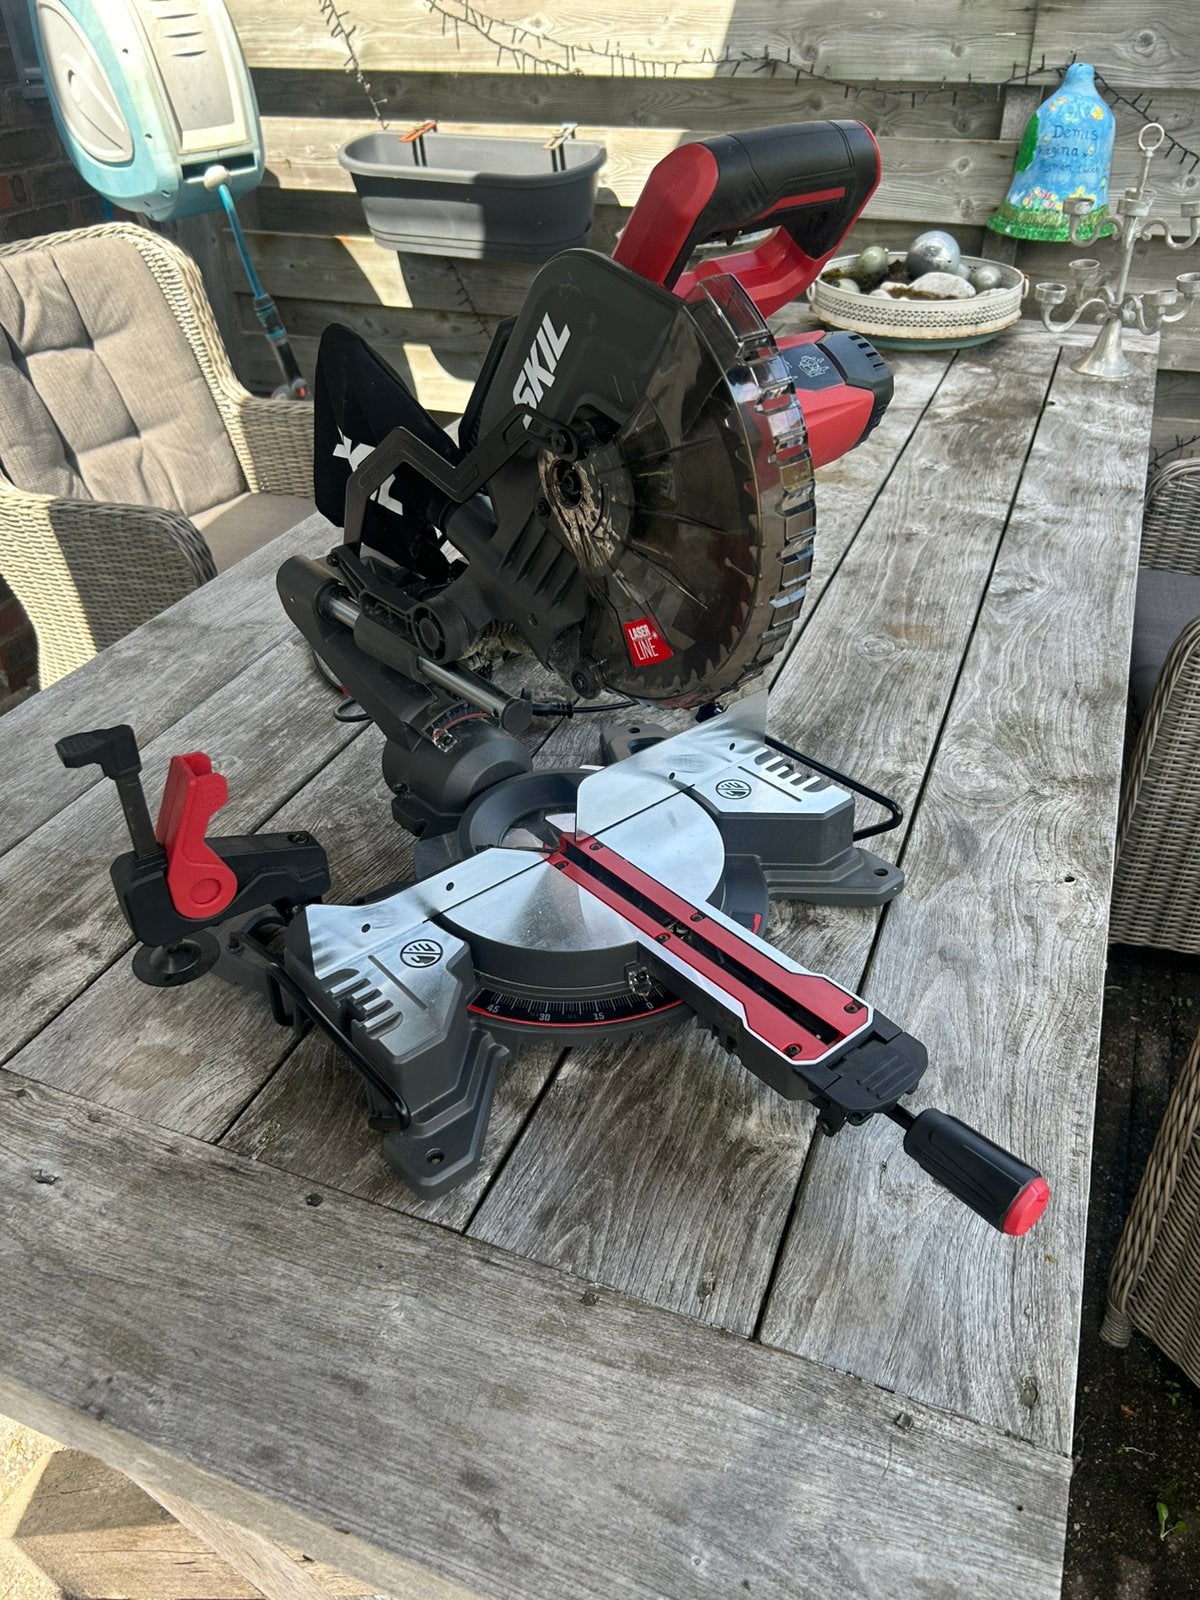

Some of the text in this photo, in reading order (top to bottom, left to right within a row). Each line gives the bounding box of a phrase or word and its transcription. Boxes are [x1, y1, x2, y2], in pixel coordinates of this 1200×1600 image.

[628, 624, 651, 640] LASER
[633, 637, 659, 660] LINE
[486, 1003, 501, 1014] 45
[538, 1013, 551, 1022] 30
[593, 1012, 605, 1021] 15
